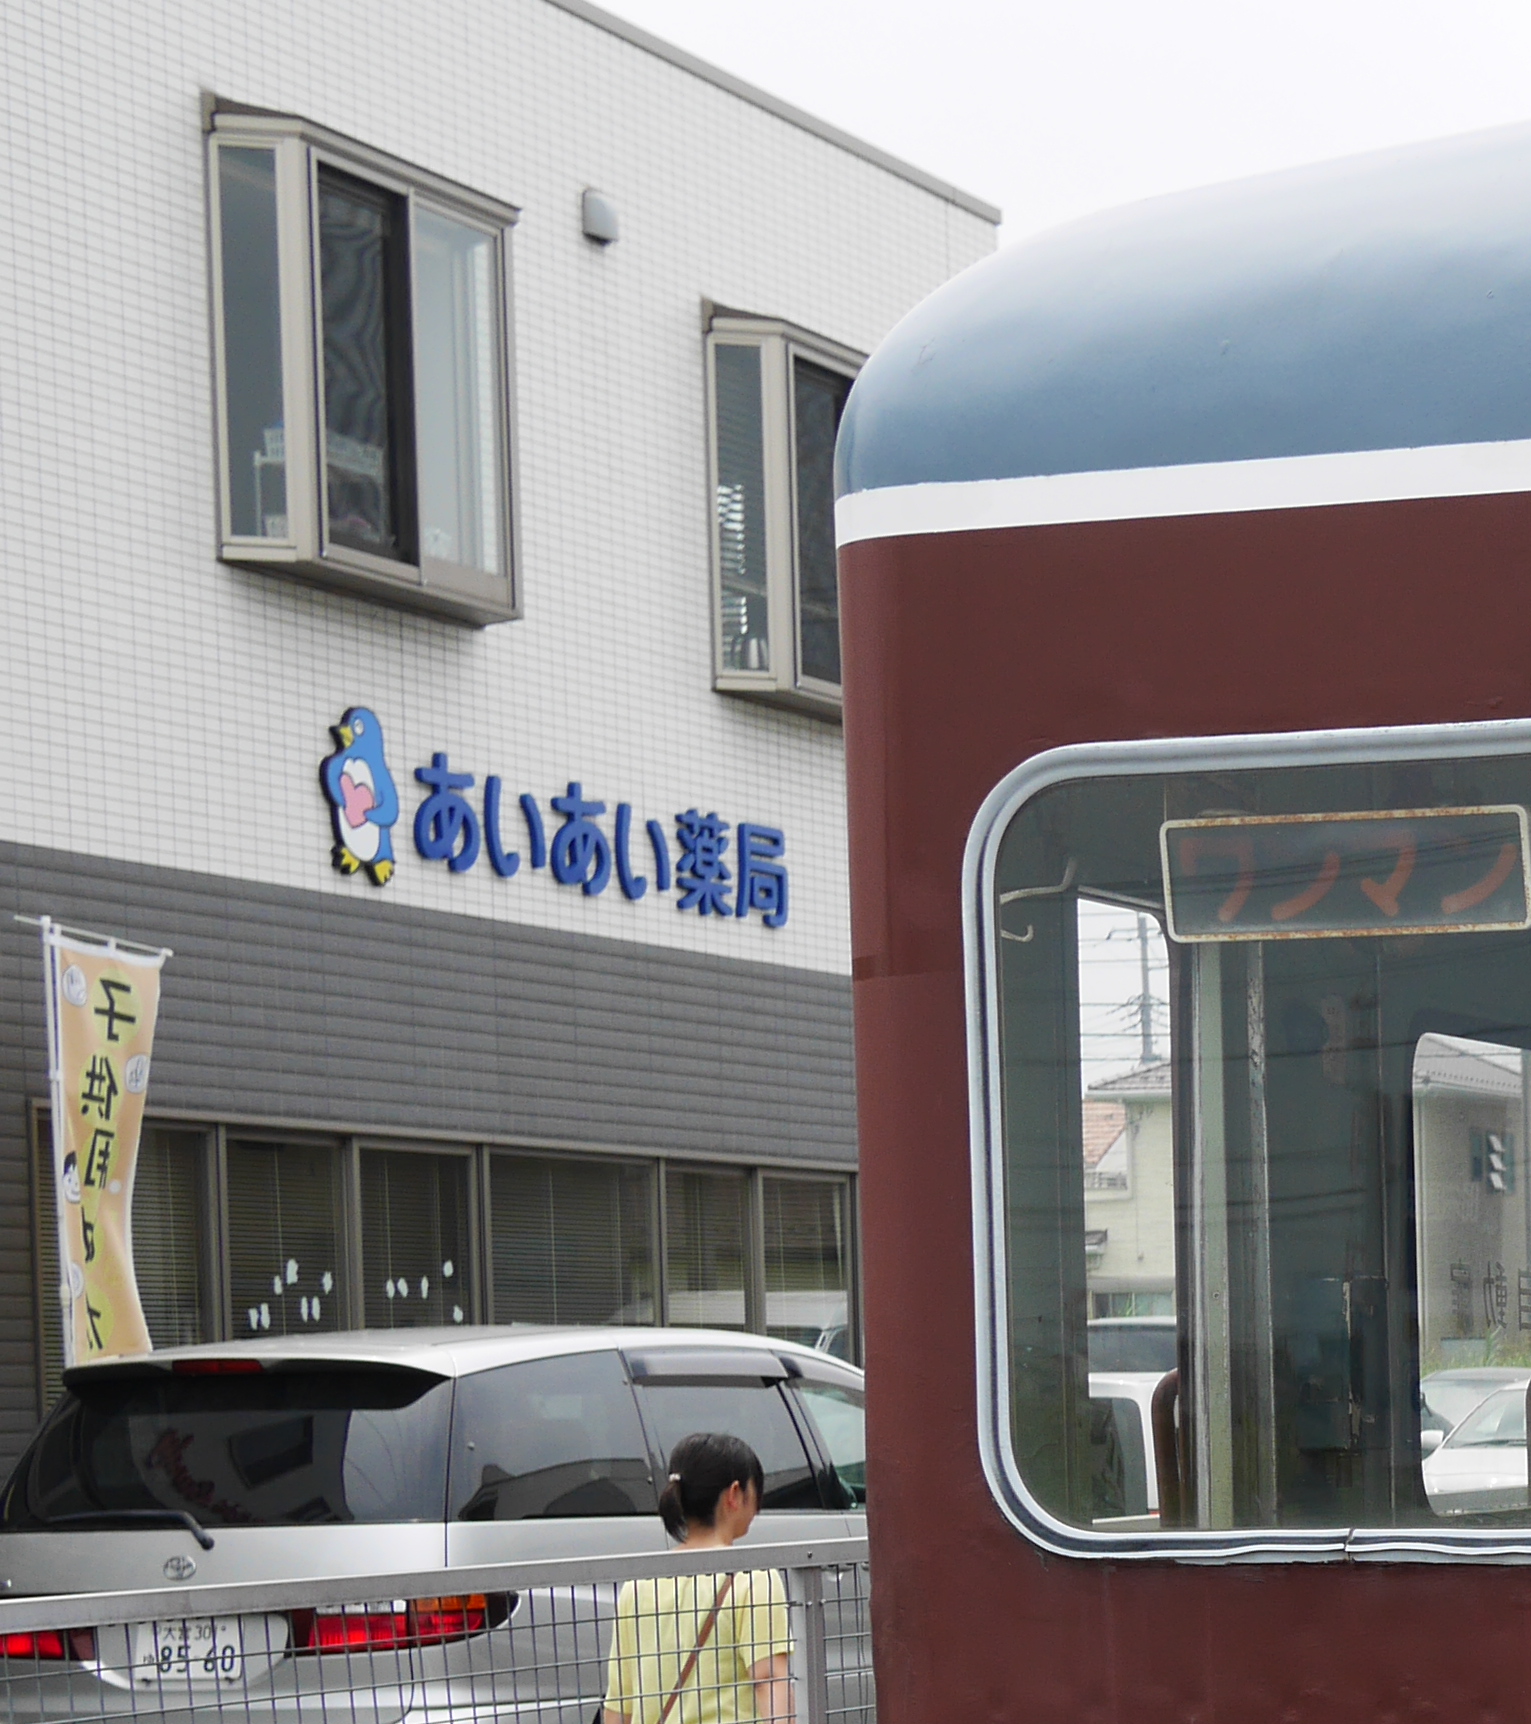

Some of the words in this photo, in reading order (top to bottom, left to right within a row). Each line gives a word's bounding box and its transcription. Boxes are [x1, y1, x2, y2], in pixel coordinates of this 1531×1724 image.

[413, 752, 789, 928] あいあい薬局
[1179, 828, 1518, 923] ワンマン
